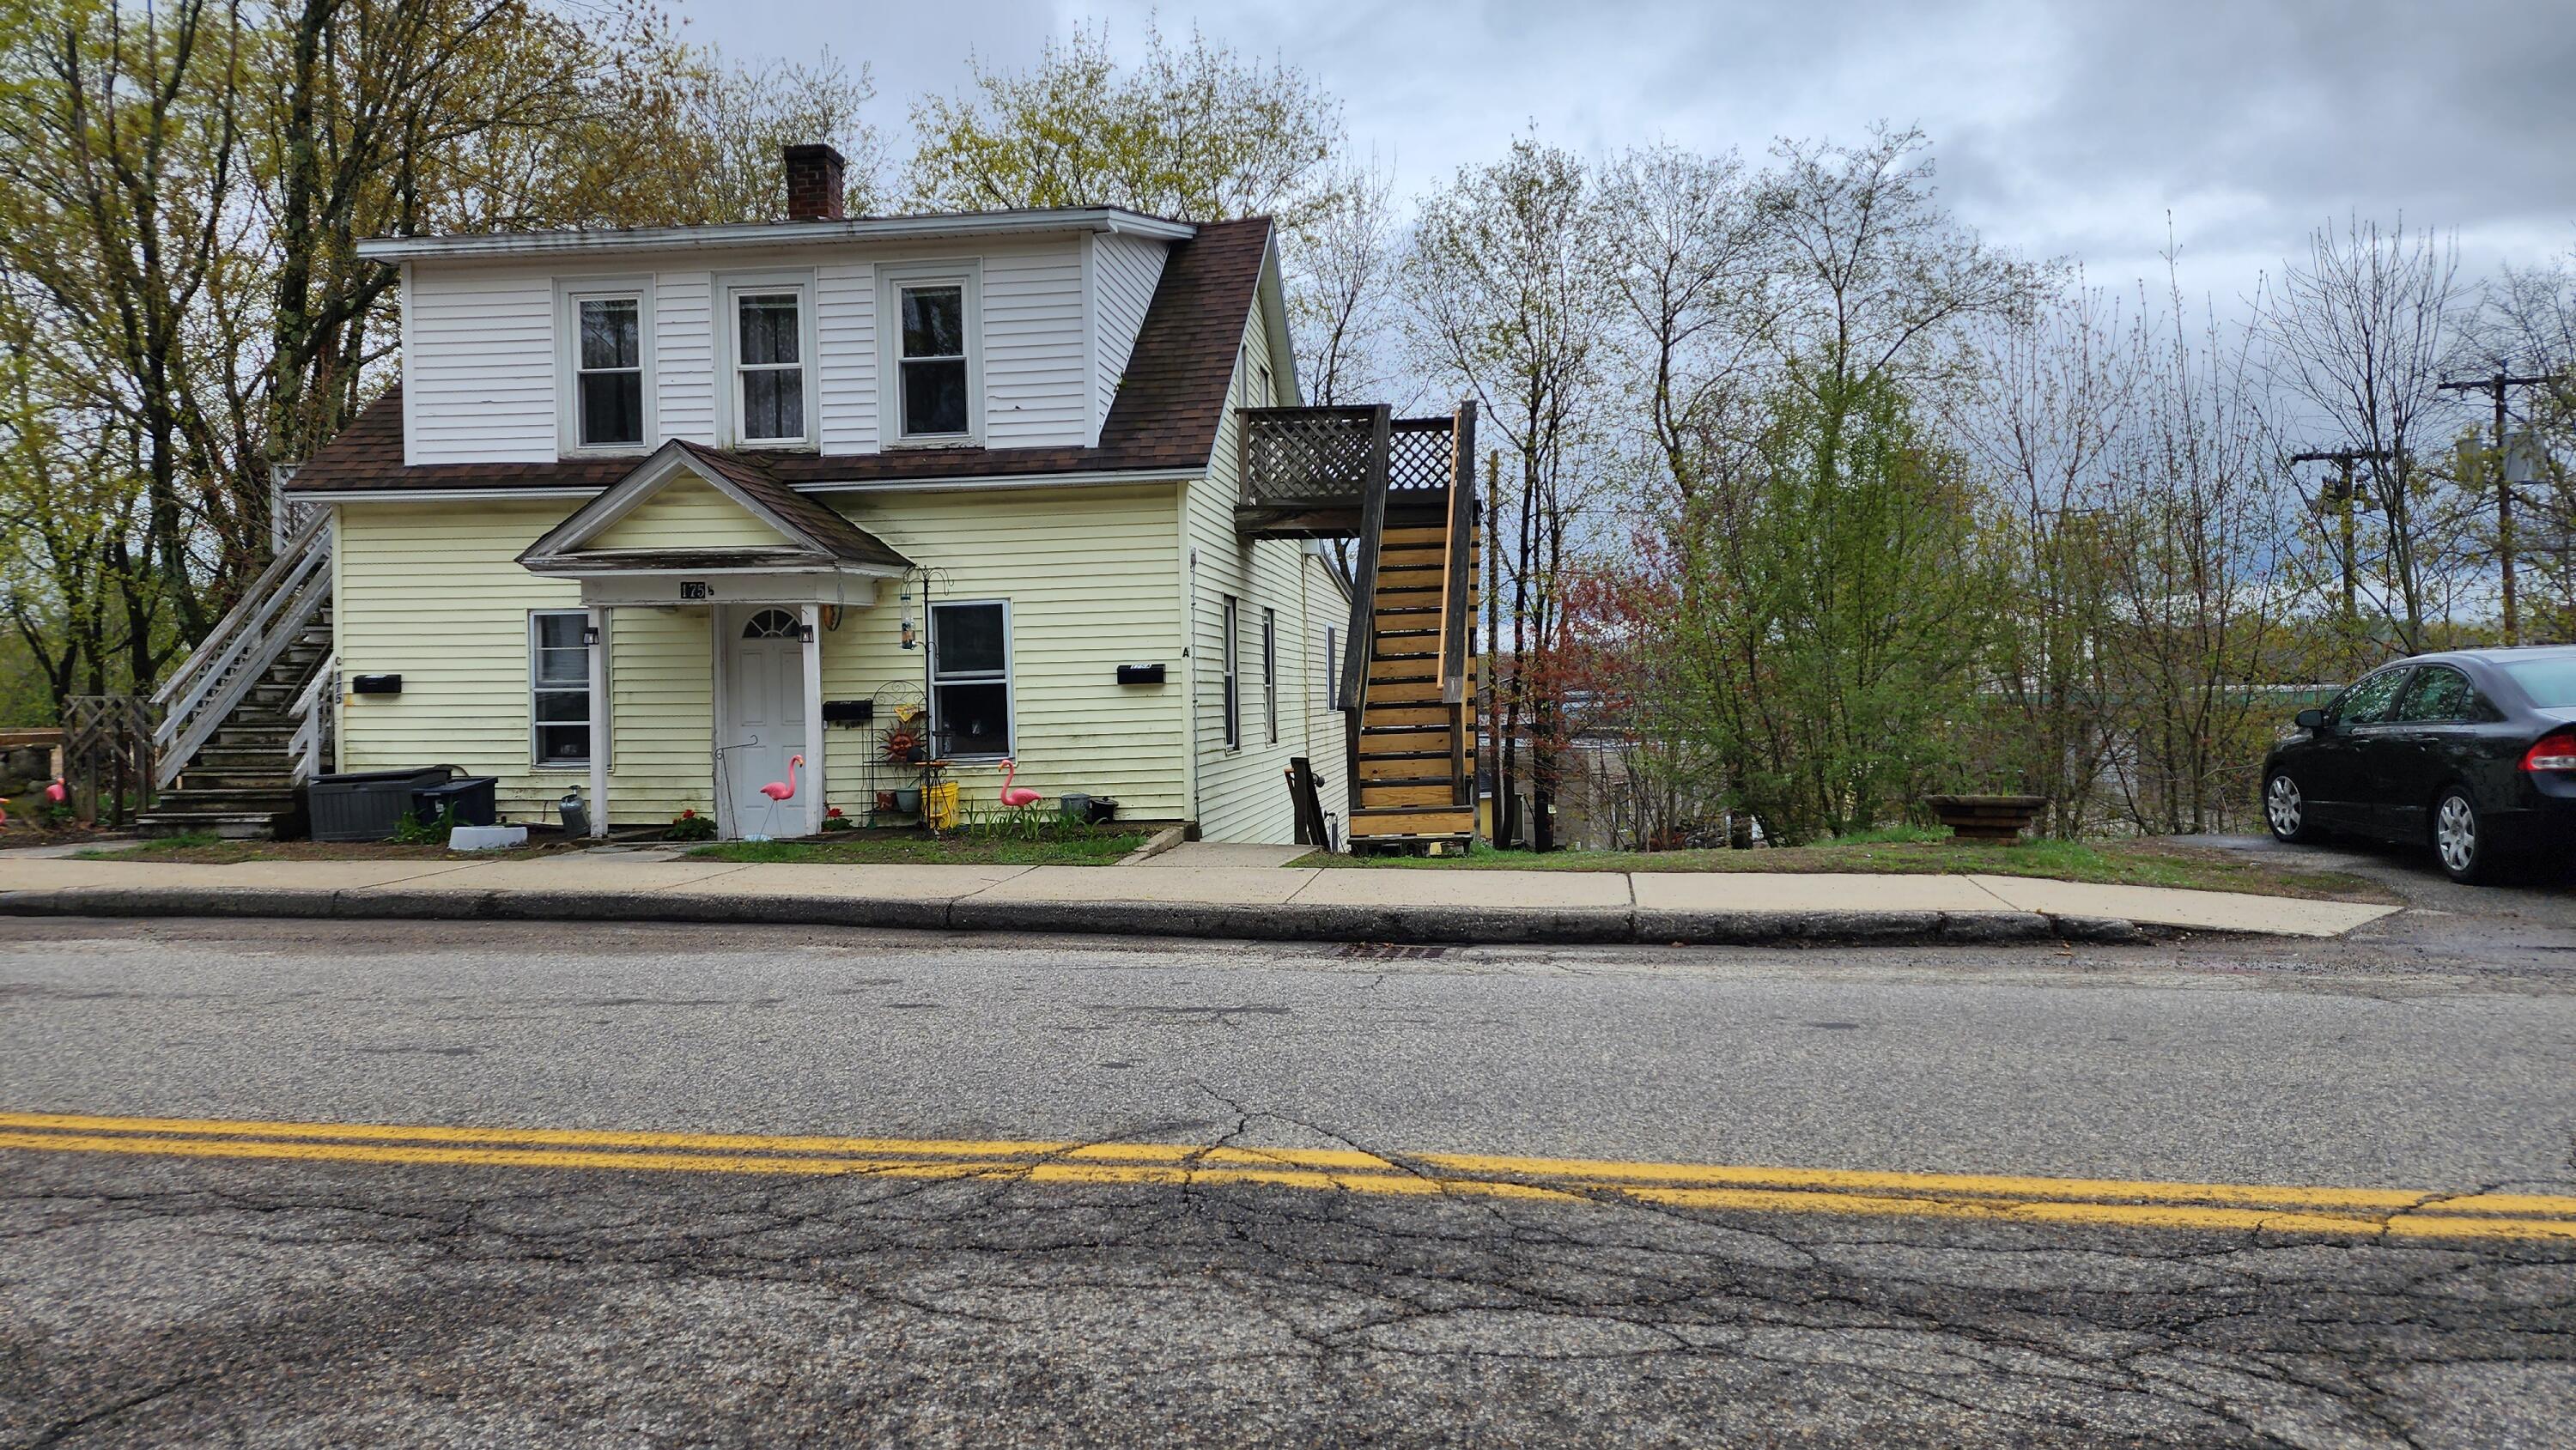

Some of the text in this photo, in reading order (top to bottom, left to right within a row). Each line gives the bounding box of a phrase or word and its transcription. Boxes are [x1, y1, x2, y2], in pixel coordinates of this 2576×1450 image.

[683, 584, 704, 598] 175
[1182, 646, 1189, 658] A
[335, 657, 342, 666] C
